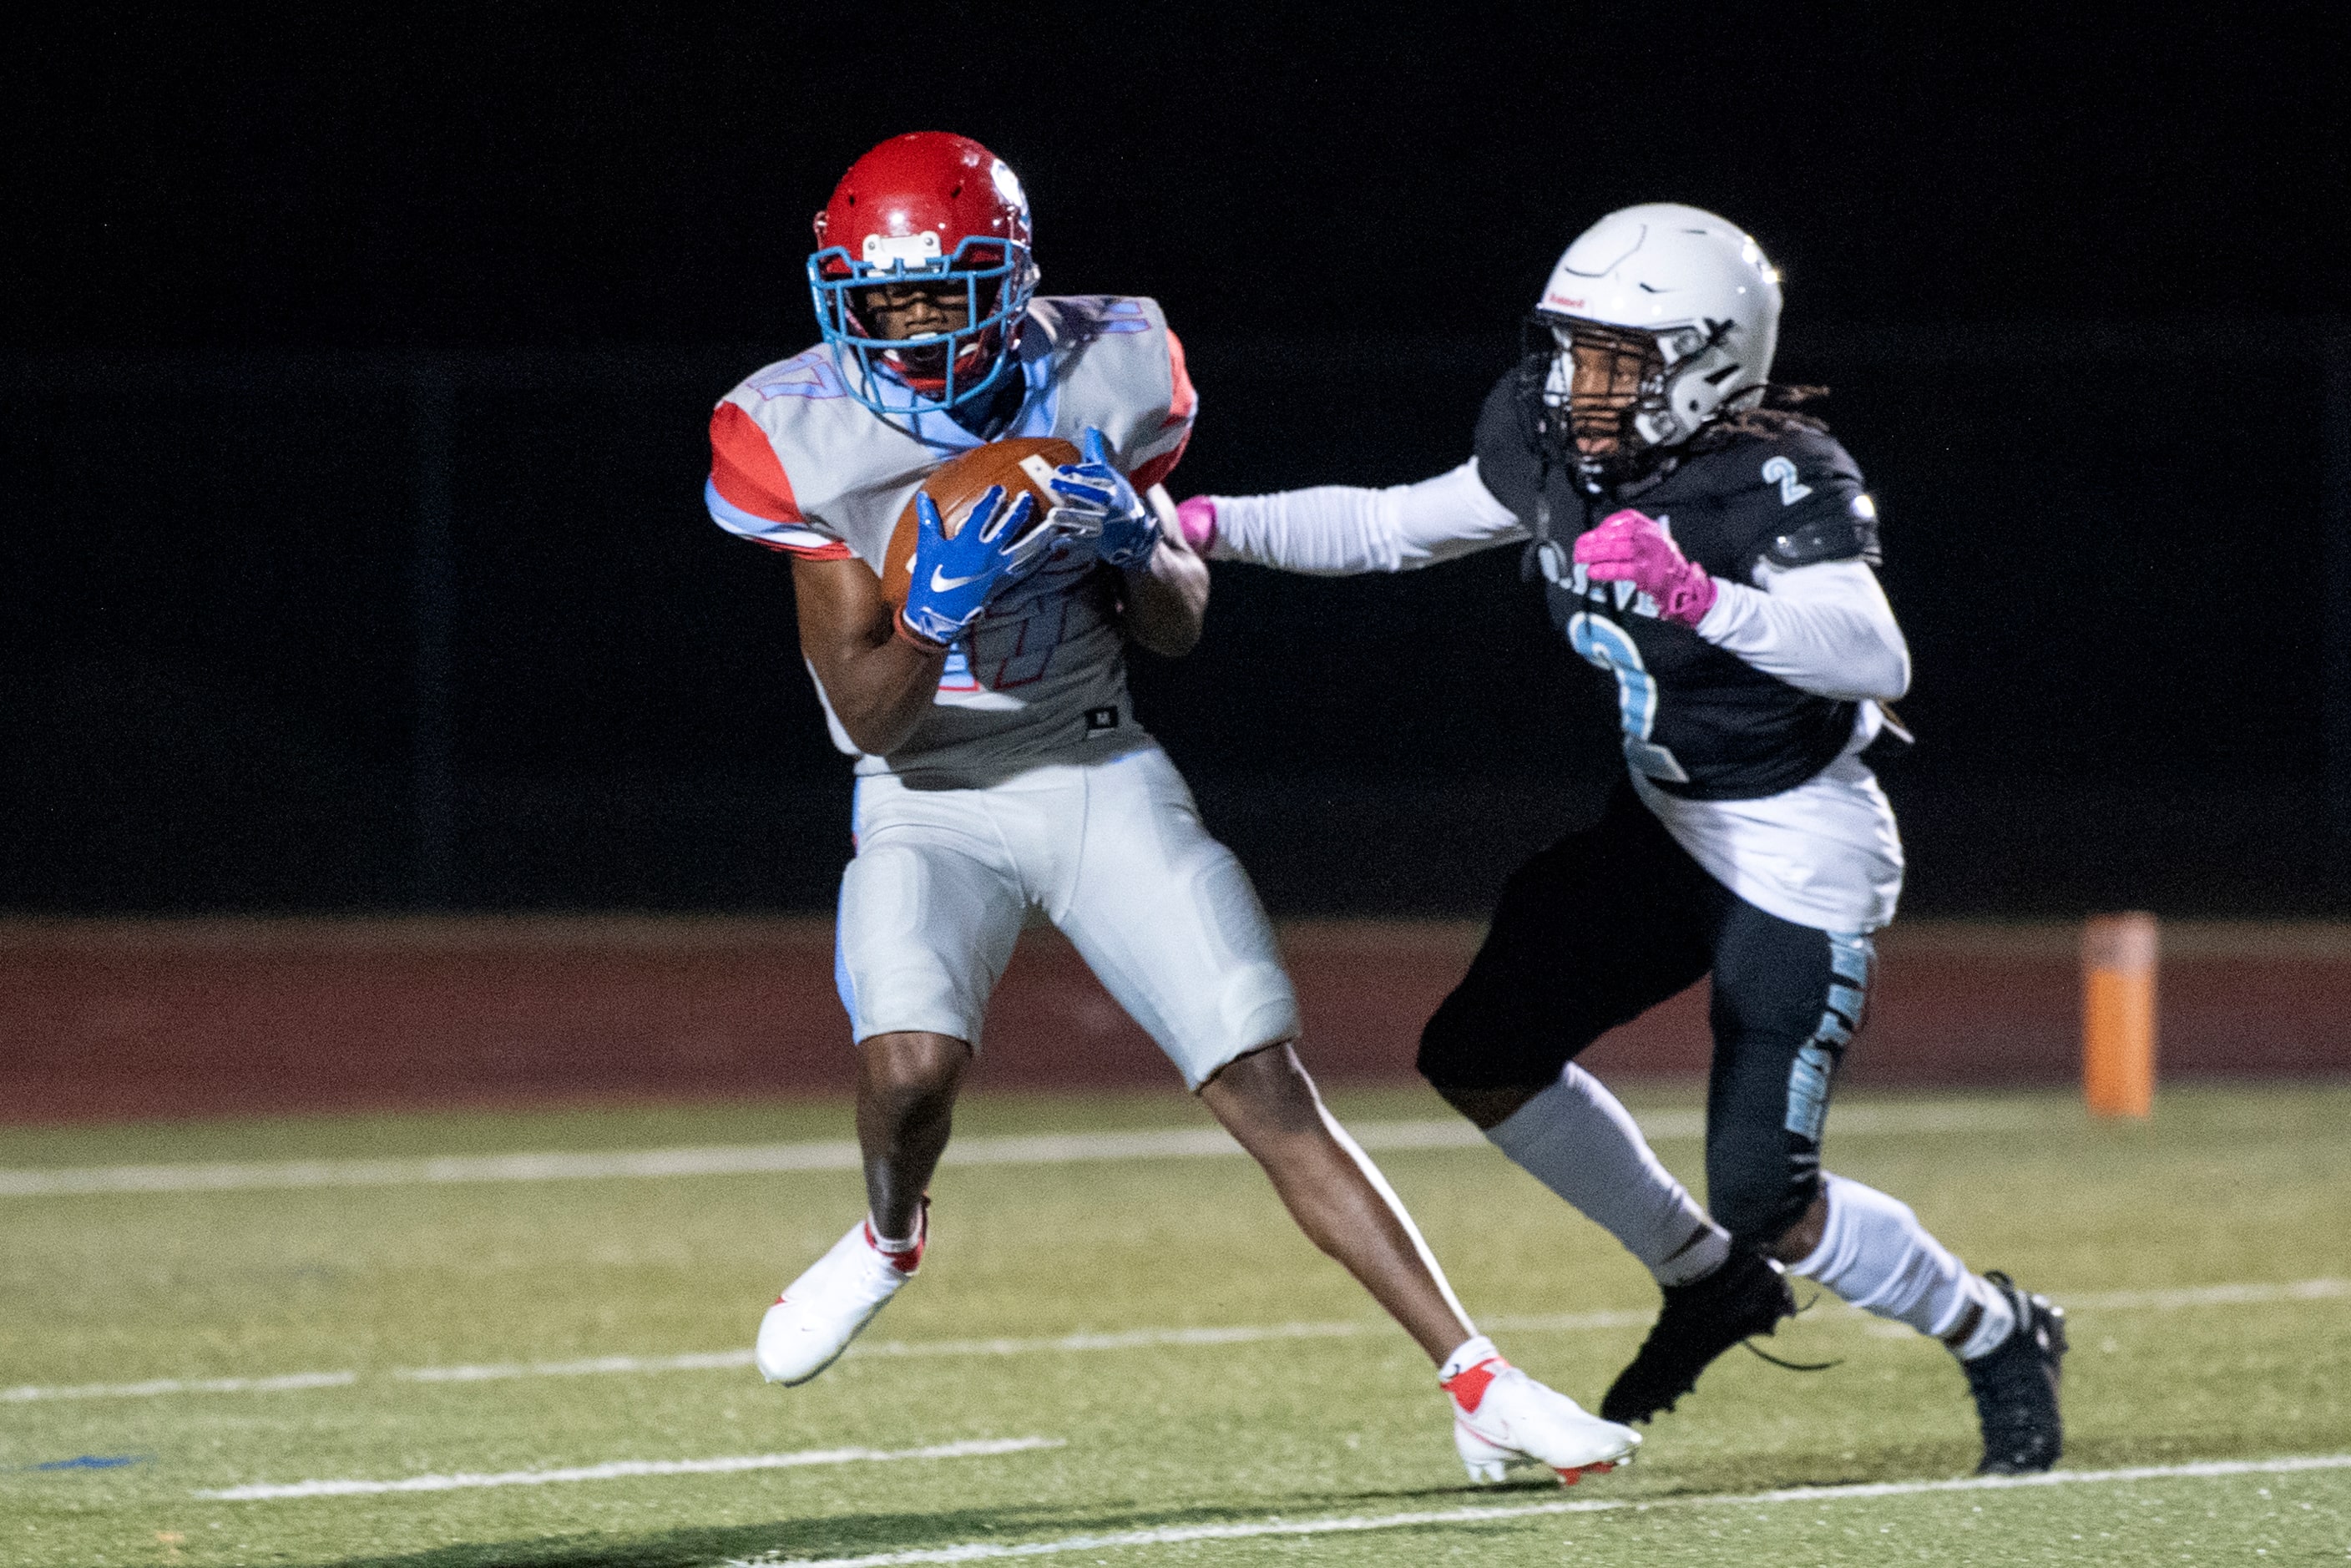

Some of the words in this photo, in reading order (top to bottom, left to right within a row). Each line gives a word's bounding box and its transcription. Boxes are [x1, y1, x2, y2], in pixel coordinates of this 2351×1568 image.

[1762, 455, 1813, 506] 2
[1568, 610, 1691, 784] 2
[1784, 931, 1875, 1141] MUSTAN
